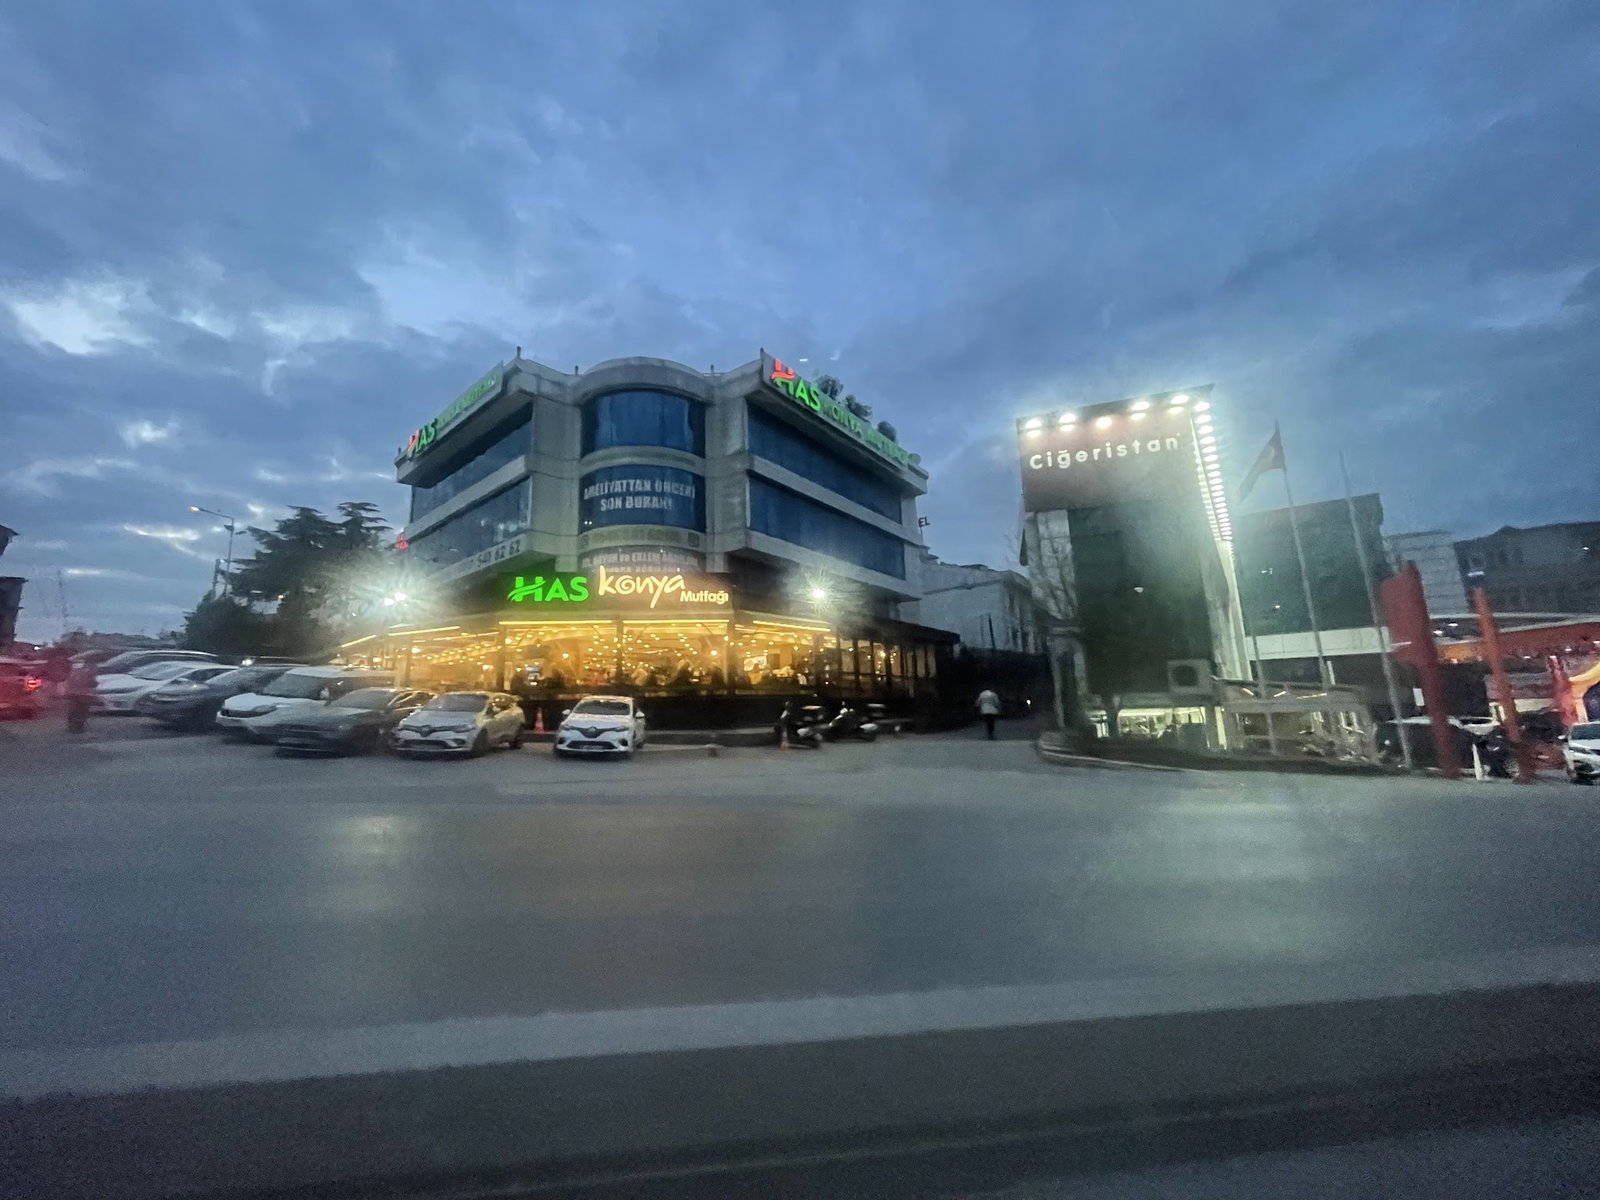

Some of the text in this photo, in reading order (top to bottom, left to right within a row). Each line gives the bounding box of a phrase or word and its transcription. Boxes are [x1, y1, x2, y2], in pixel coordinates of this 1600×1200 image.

[771, 358, 820, 412] HAS
[600, 497, 623, 511] SON
[508, 576, 588, 602] HAS
